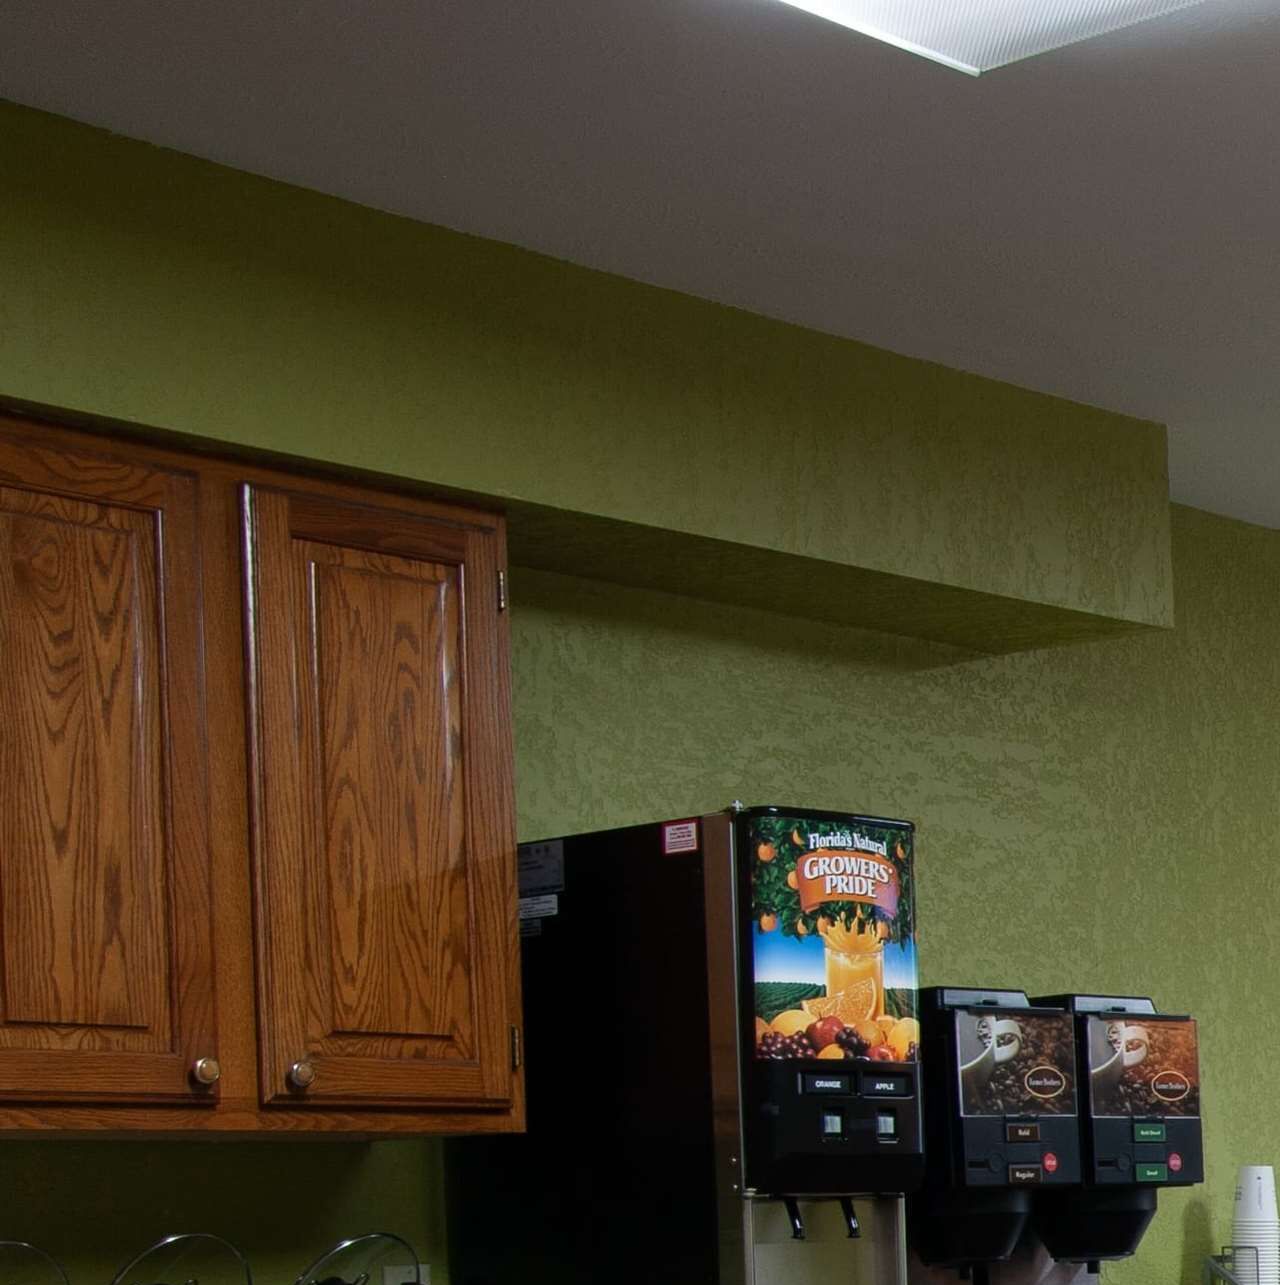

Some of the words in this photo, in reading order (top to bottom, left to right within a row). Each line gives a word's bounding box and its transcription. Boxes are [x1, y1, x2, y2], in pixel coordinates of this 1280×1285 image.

[809, 831, 853, 849] Florida's
[853, 833, 887, 855] Natural
[825, 875, 877, 898] PRIDE
[815, 1080, 841, 1088] ORANGE
